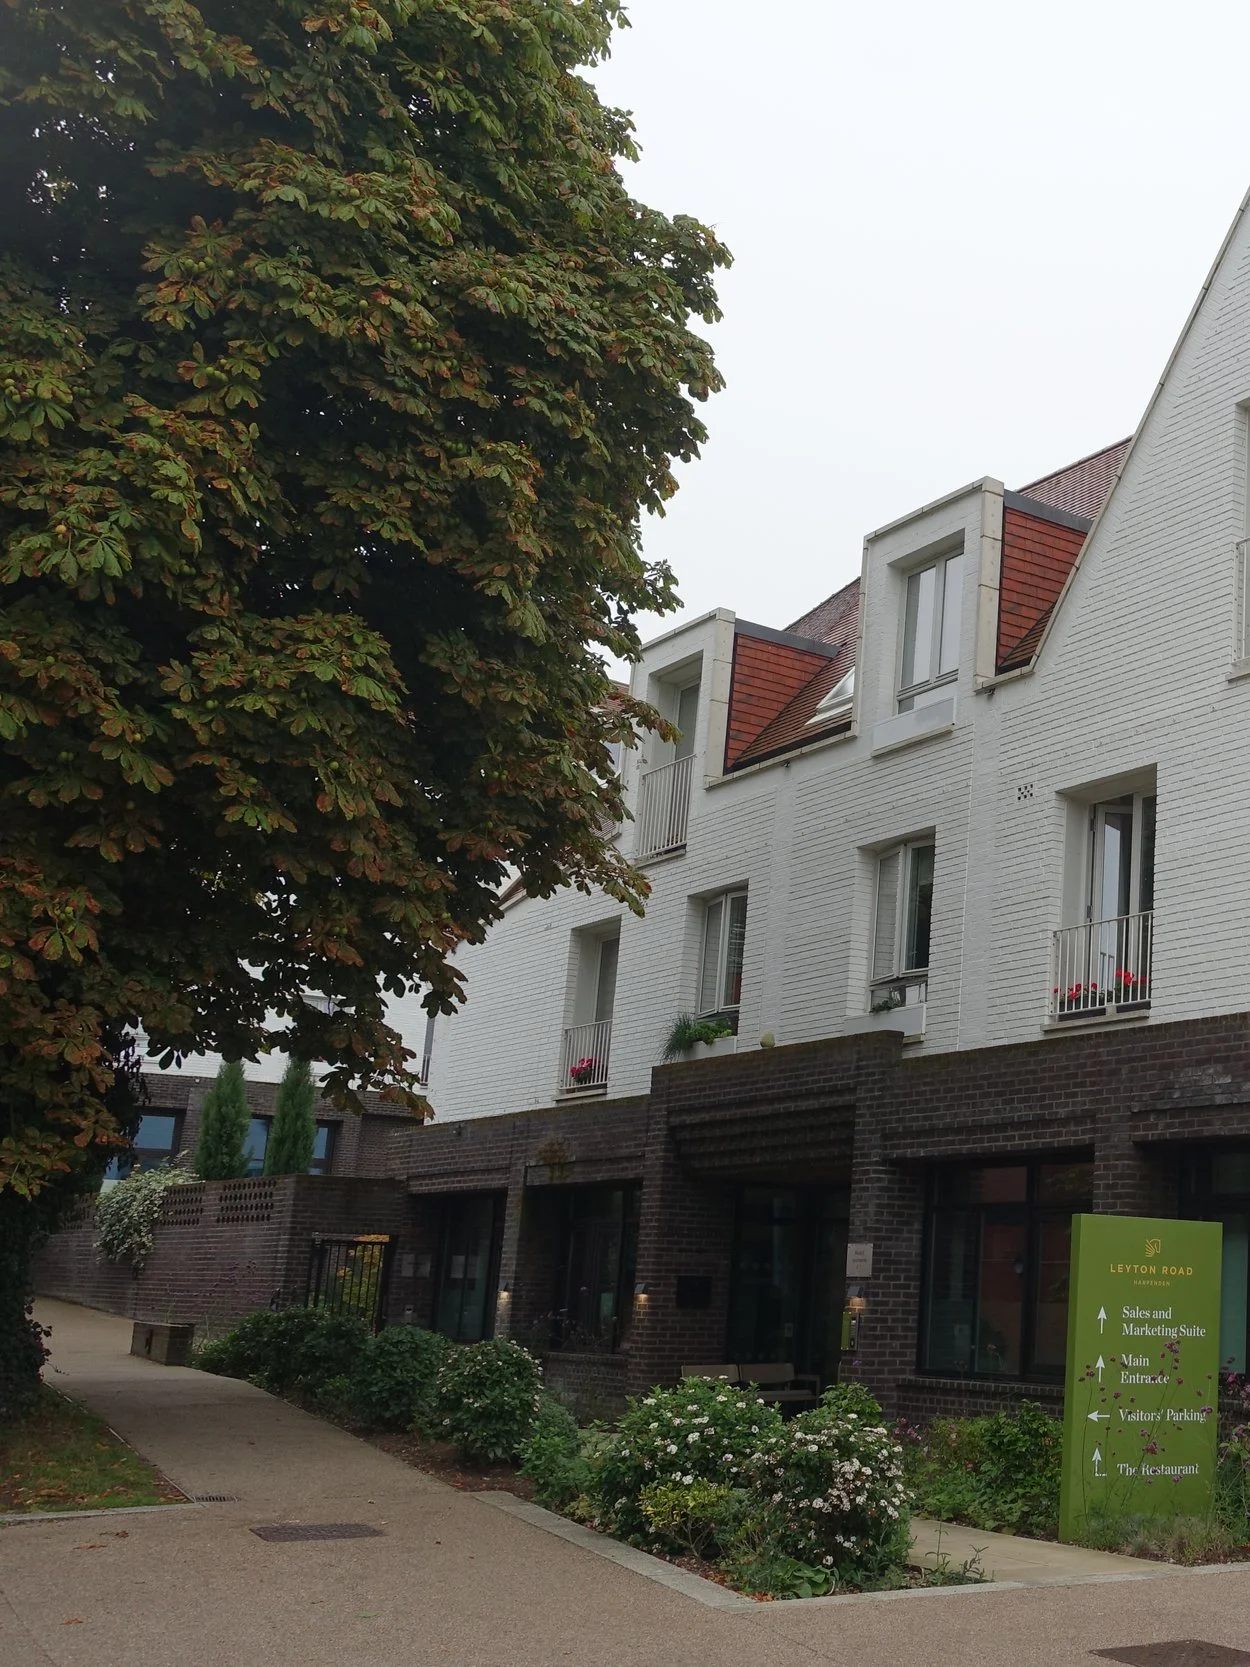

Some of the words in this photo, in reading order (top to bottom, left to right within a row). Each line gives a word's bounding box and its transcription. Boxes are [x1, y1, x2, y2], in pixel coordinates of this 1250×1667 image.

[1110, 1264, 1156, 1274] LEYTON
[1162, 1266, 1193, 1275] ROAD
[1122, 1305, 1151, 1319] Sales
[1152, 1307, 1172, 1319] and
[1122, 1323, 1178, 1339] Marketing
[1179, 1324, 1206, 1337] Suite
[1121, 1353, 1150, 1367] Main
[1166, 1408, 1207, 1424] Parking
[1116, 1463, 1138, 1476] The
[1141, 1463, 1199, 1476] Restaurant
